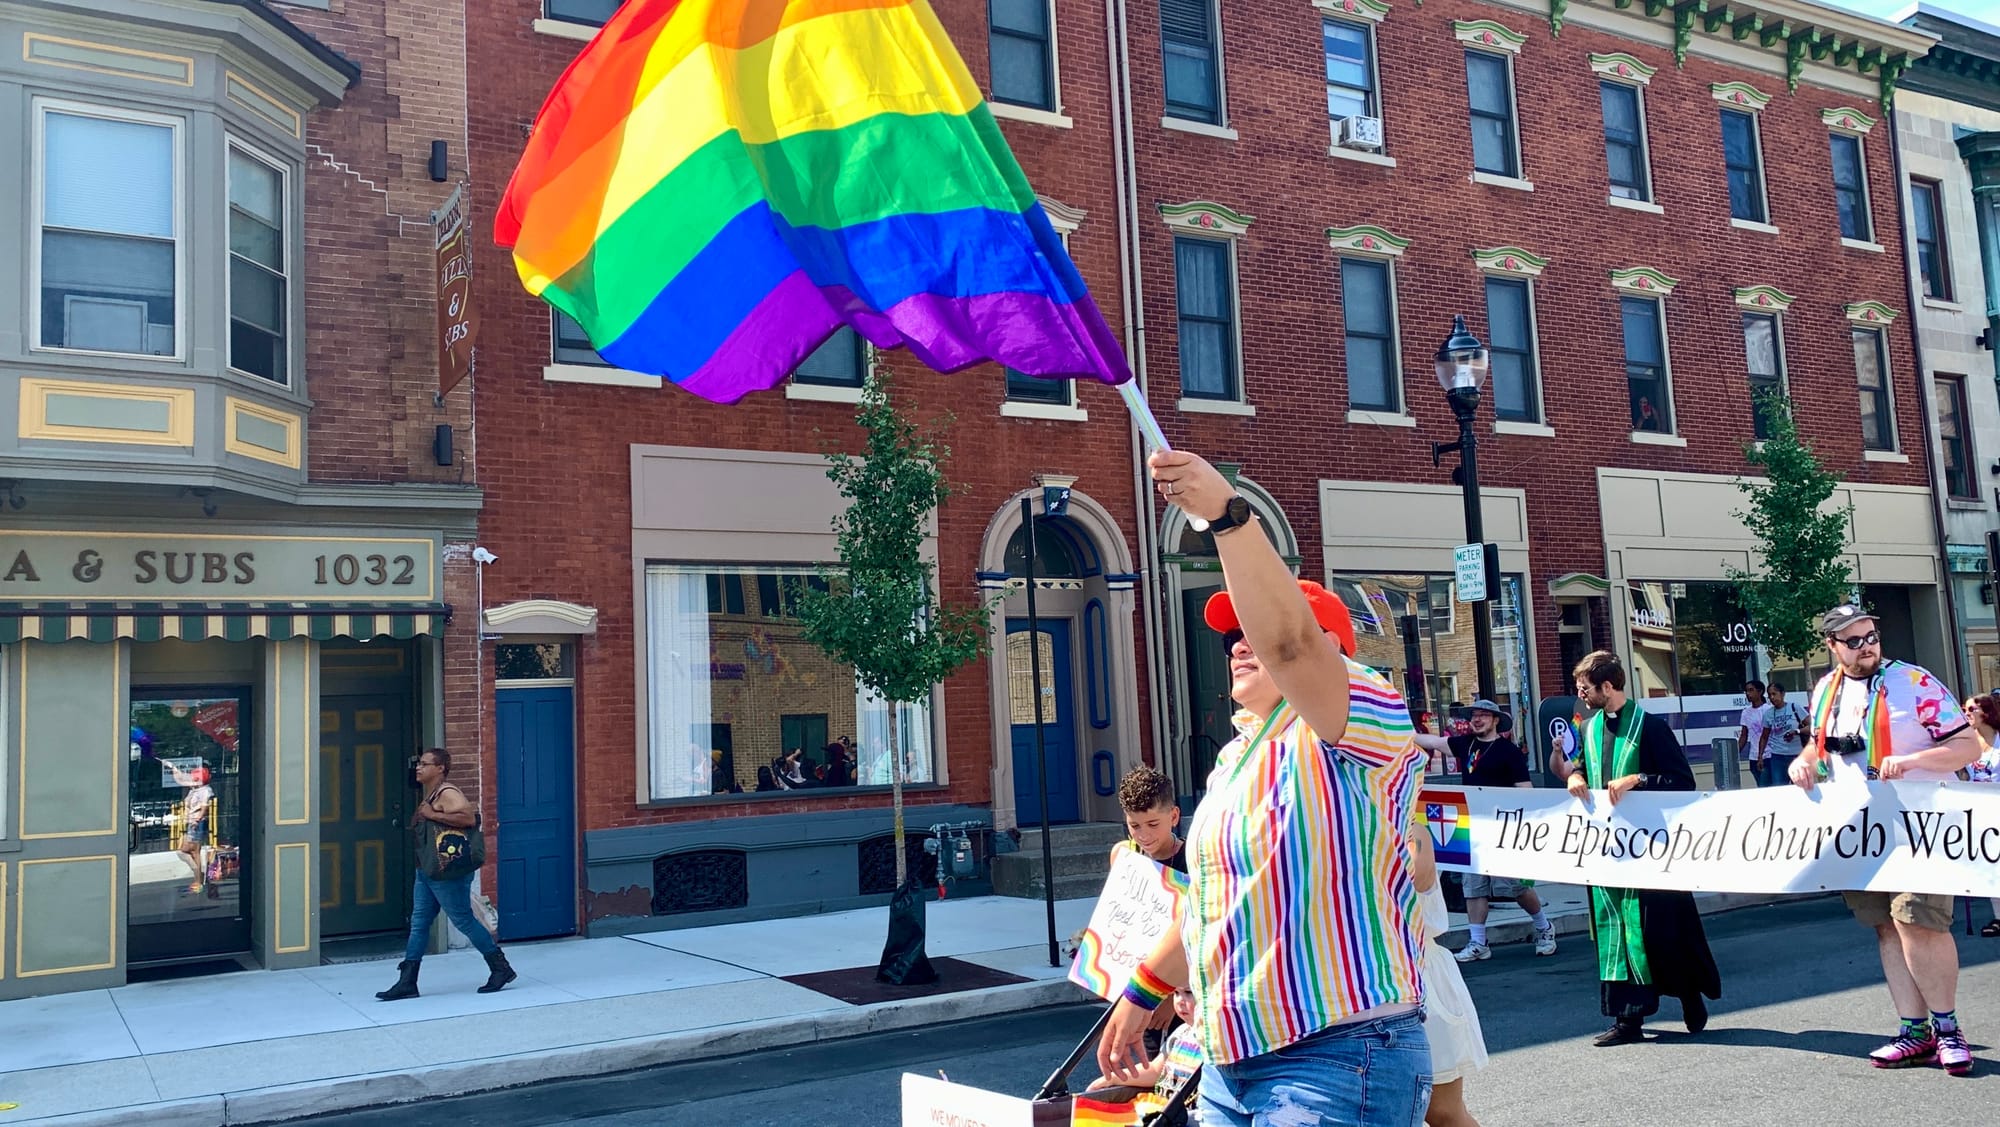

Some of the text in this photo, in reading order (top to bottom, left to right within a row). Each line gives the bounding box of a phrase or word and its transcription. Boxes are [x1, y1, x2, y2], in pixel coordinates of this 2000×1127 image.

[442, 257, 469, 285] IZZA
[448, 292, 460, 317] &
[1456, 549, 1480, 561] METER
[72, 549, 104, 583] &
[135, 550, 256, 585] SUBS
[315, 554, 416, 585] 1032
[1459, 563, 1480, 572] PARKING
[1462, 573, 1477, 581] ONLY
[1634, 609, 1665, 627] 1038
[1495, 806, 2000, 873] The Episcopal Church Welc
[930, 1106, 946, 1126] WE
